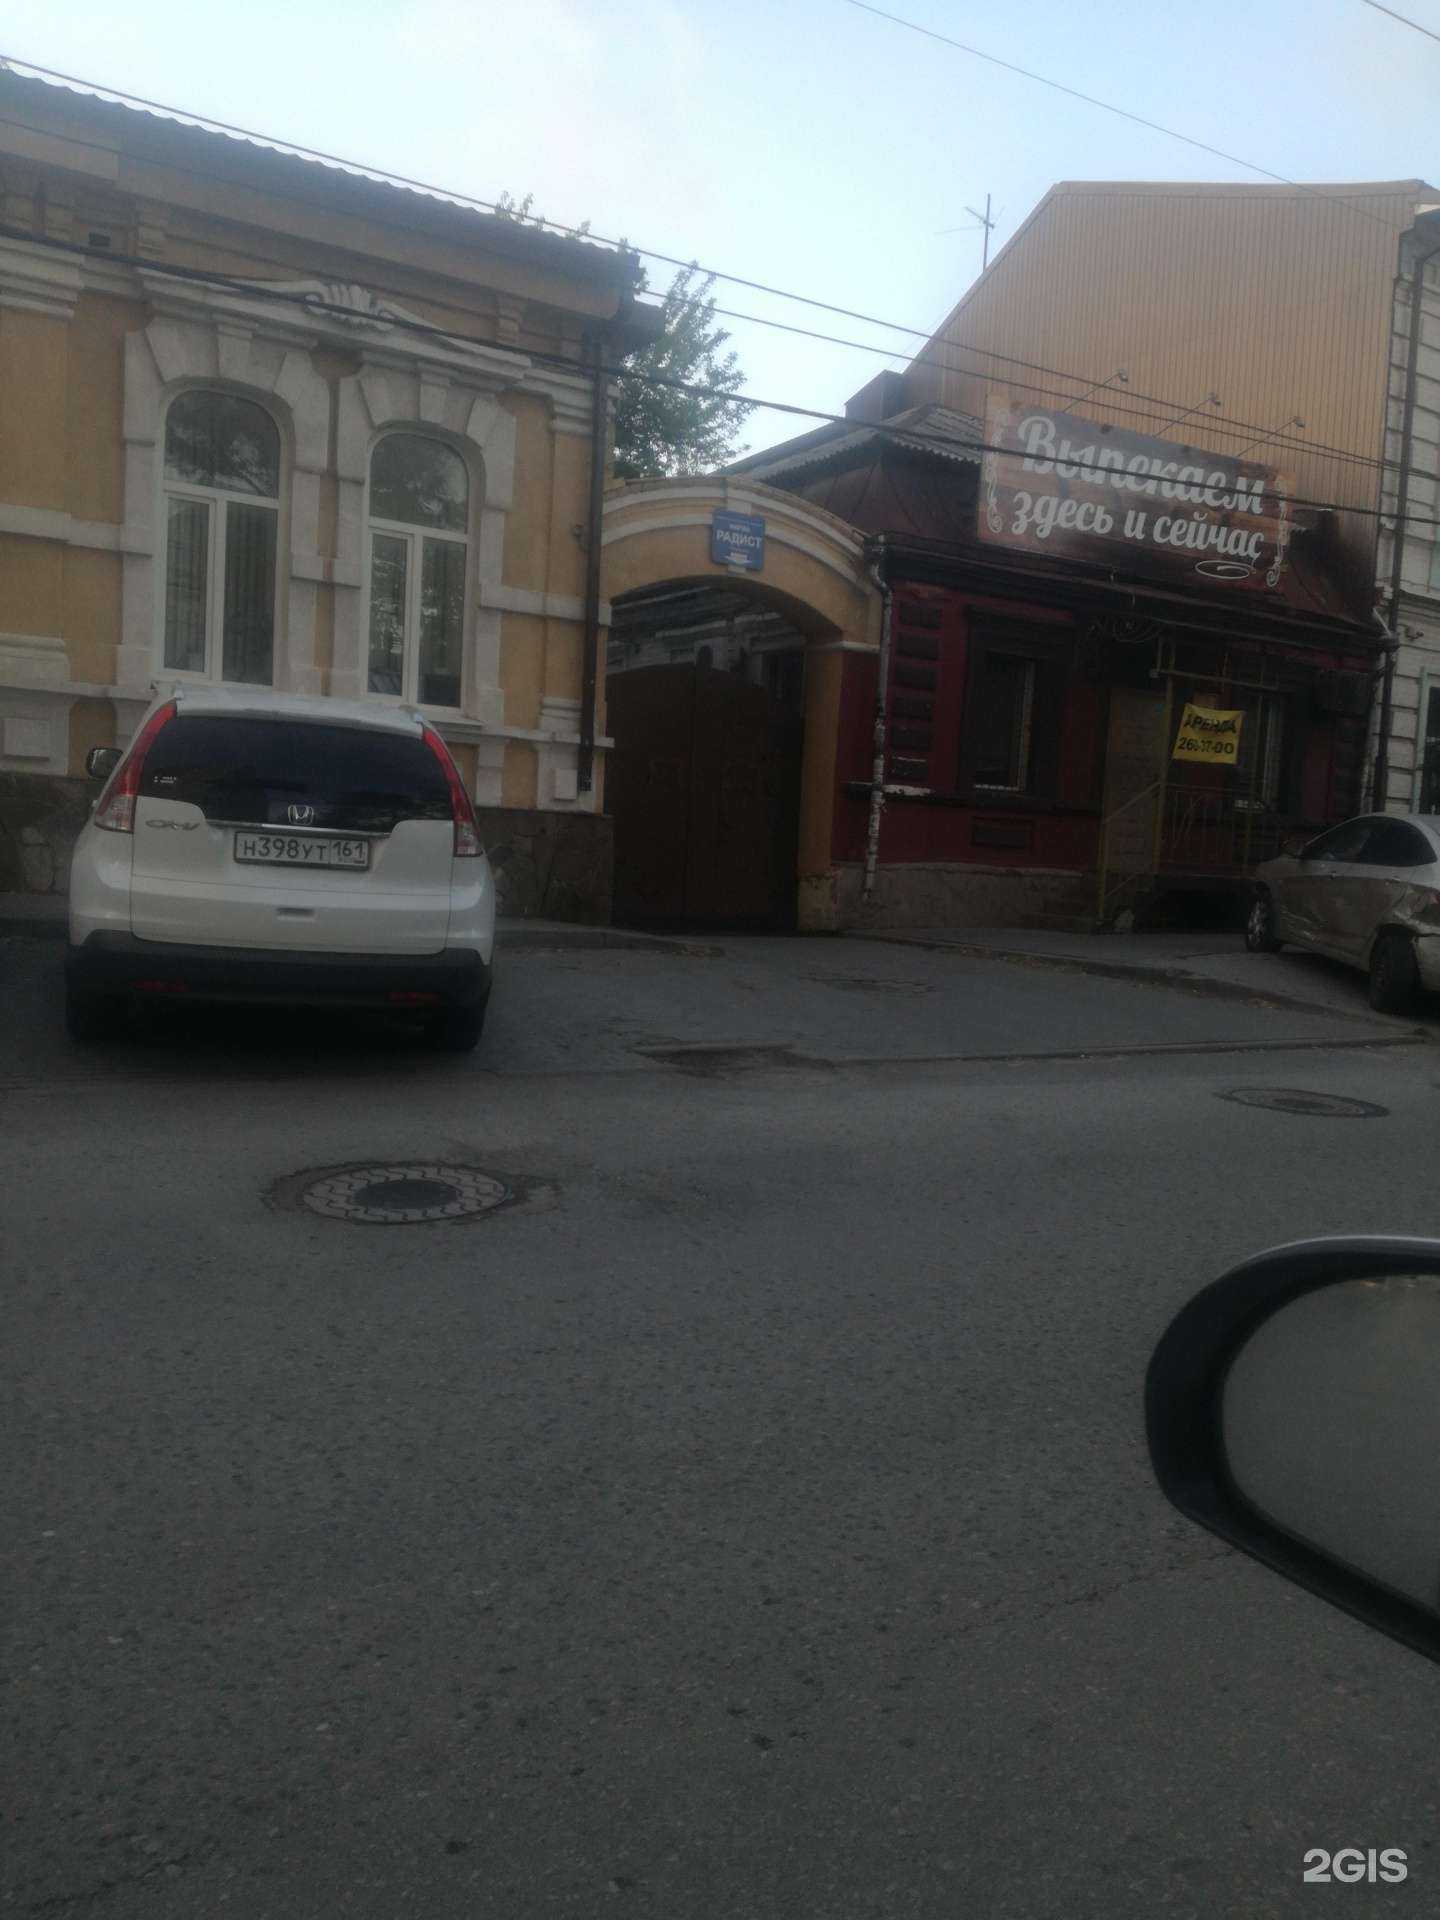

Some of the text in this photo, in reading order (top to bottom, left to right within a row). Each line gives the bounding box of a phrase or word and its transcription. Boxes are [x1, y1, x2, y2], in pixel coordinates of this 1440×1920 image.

[1017, 415, 1266, 515] Выпекаем
[716, 529, 762, 549] РАДИСТ
[1011, 491, 1265, 562] здесь и сейчас
[332, 841, 365, 859] 161
